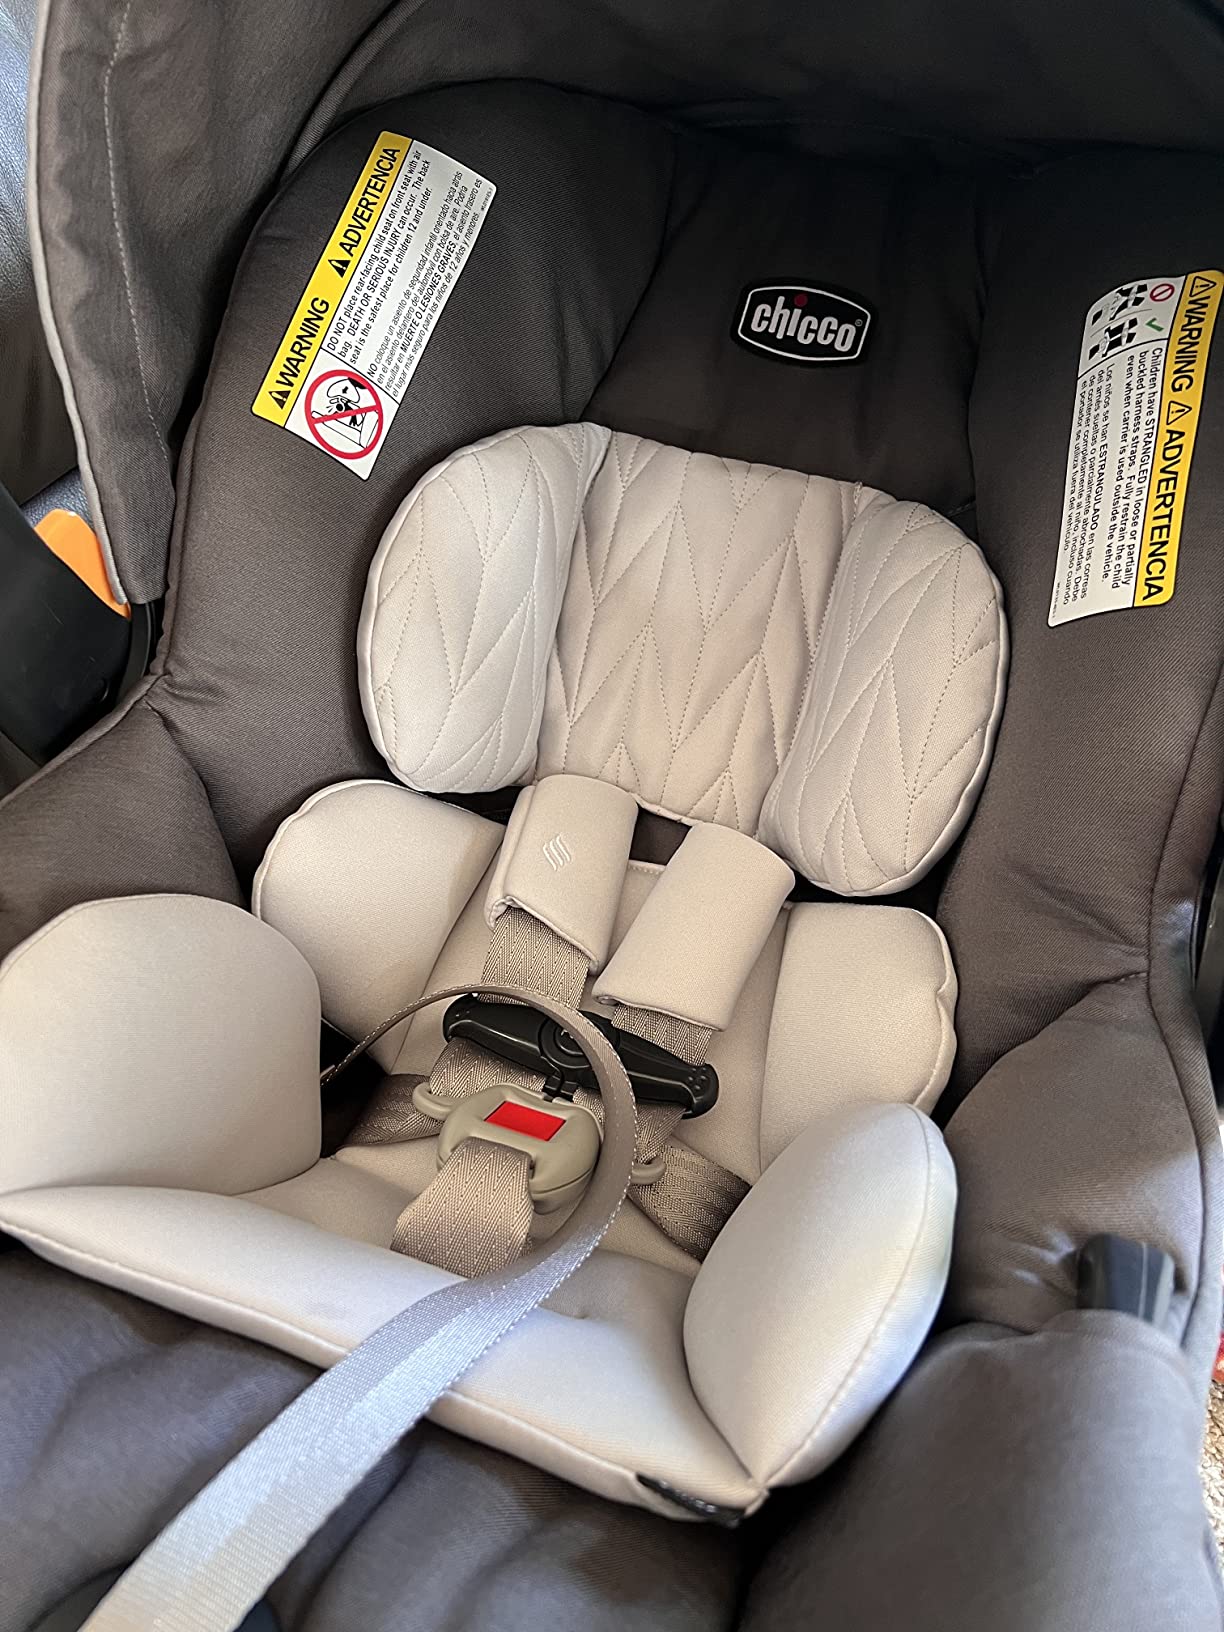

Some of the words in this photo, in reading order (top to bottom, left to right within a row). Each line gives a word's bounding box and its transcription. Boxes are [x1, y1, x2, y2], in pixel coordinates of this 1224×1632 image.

[408, 160, 417, 174] with
[412, 150, 421, 160] air
[400, 174, 411, 190] seat
[474, 178, 482, 188] es
[391, 190, 405, 208] front
[419, 188, 432, 209] under.
[381, 218, 393, 234] seat
[388, 209, 397, 219] on
[413, 208, 423, 224] and
[456, 209, 469, 233] asiento
[407, 222, 417, 232] 12
[347, 307, 364, 336] DEATH
[360, 292, 371, 306] OR
[367, 256, 388, 292] SERIOUS
[384, 228, 400, 256] INJURY
[397, 215, 407, 229] can
[403, 194, 417, 215] occur.
[411, 176, 423, 189] The
[418, 160, 430, 176] back
[373, 234, 385, 253] child
[395, 234, 412, 263] children
[275, 297, 329, 387] WARNING
[338, 148, 400, 257] ADVERTENCIA
[354, 254, 378, 294] rear-facing
[388, 263, 398, 275] for
[380, 276, 393, 299] place
[419, 272, 441, 312] LESIONES
[344, 295, 357, 318] place
[367, 363, 377, 377] NO
[374, 336, 390, 364] coloque
[387, 325, 395, 335] un
[392, 299, 406, 325] asiento
[424, 232, 437, 255] infantil
[368, 297, 383, 322] safest
[377, 373, 384, 384] en
[385, 339, 399, 365] asiento
[396, 306, 414, 339] delantero
[432, 248, 442, 262] con
[437, 229, 450, 248] bolsa
[394, 369, 406, 389] lugar
[411, 329, 425, 354] seguro
[422, 313, 433, 331] para
[428, 302, 438, 313] los
[435, 282, 447, 302] niños
[448, 261, 458, 272] 12
[454, 245, 465, 263] años
[462, 239, 469, 247] y
[415, 311, 422, 319] O
[333, 316, 346, 336] NOT
[360, 323, 371, 336] the
[400, 319, 419, 352] MUERTE
[326, 336, 338, 350] DO
[356, 337, 365, 346] is
[1171, 298, 1209, 393] WARNING
[350, 345, 361, 364] seat
[397, 352, 404, 363] en
[1126, 355, 1134, 378] even
[1106, 363, 1114, 381] Los
[1136, 350, 1148, 389] buckled
[1149, 347, 1162, 389] Children
[1103, 383, 1112, 408] niños
[1124, 380, 1133, 408] when
[1146, 391, 1157, 416] have
[1133, 392, 1144, 432] harness
[1100, 423, 1109, 441] han
[1121, 410, 1130, 442] carrier
[1119, 444, 1128, 454] is
[1128, 435, 1139, 470] straps.
[1138, 418, 1154, 483] STRANGLED
[1116, 457, 1124, 481] used
[1083, 457, 1095, 514] parcialmente
[1090, 444, 1107, 529] ESTRANGULADO
[1122, 475, 1135, 499] Fully
[1135, 486, 1145, 496] in
[1110, 484, 1121, 521] outside
[1131, 498, 1143, 526] loose
[1118, 503, 1129, 541] restrain
[1143, 429, 1185, 601] ADVERTENCIA
[1088, 532, 1094, 545] en
[1107, 523, 1117, 540] the
[1129, 529, 1137, 540] or
[1085, 546, 1094, 561] las
[1102, 542, 1112, 581] vehicle.
[1115, 544, 1125, 560] the
[1122, 544, 1134, 584] partially
[1080, 563, 1090, 598] correas
[1111, 563, 1122, 588] child
